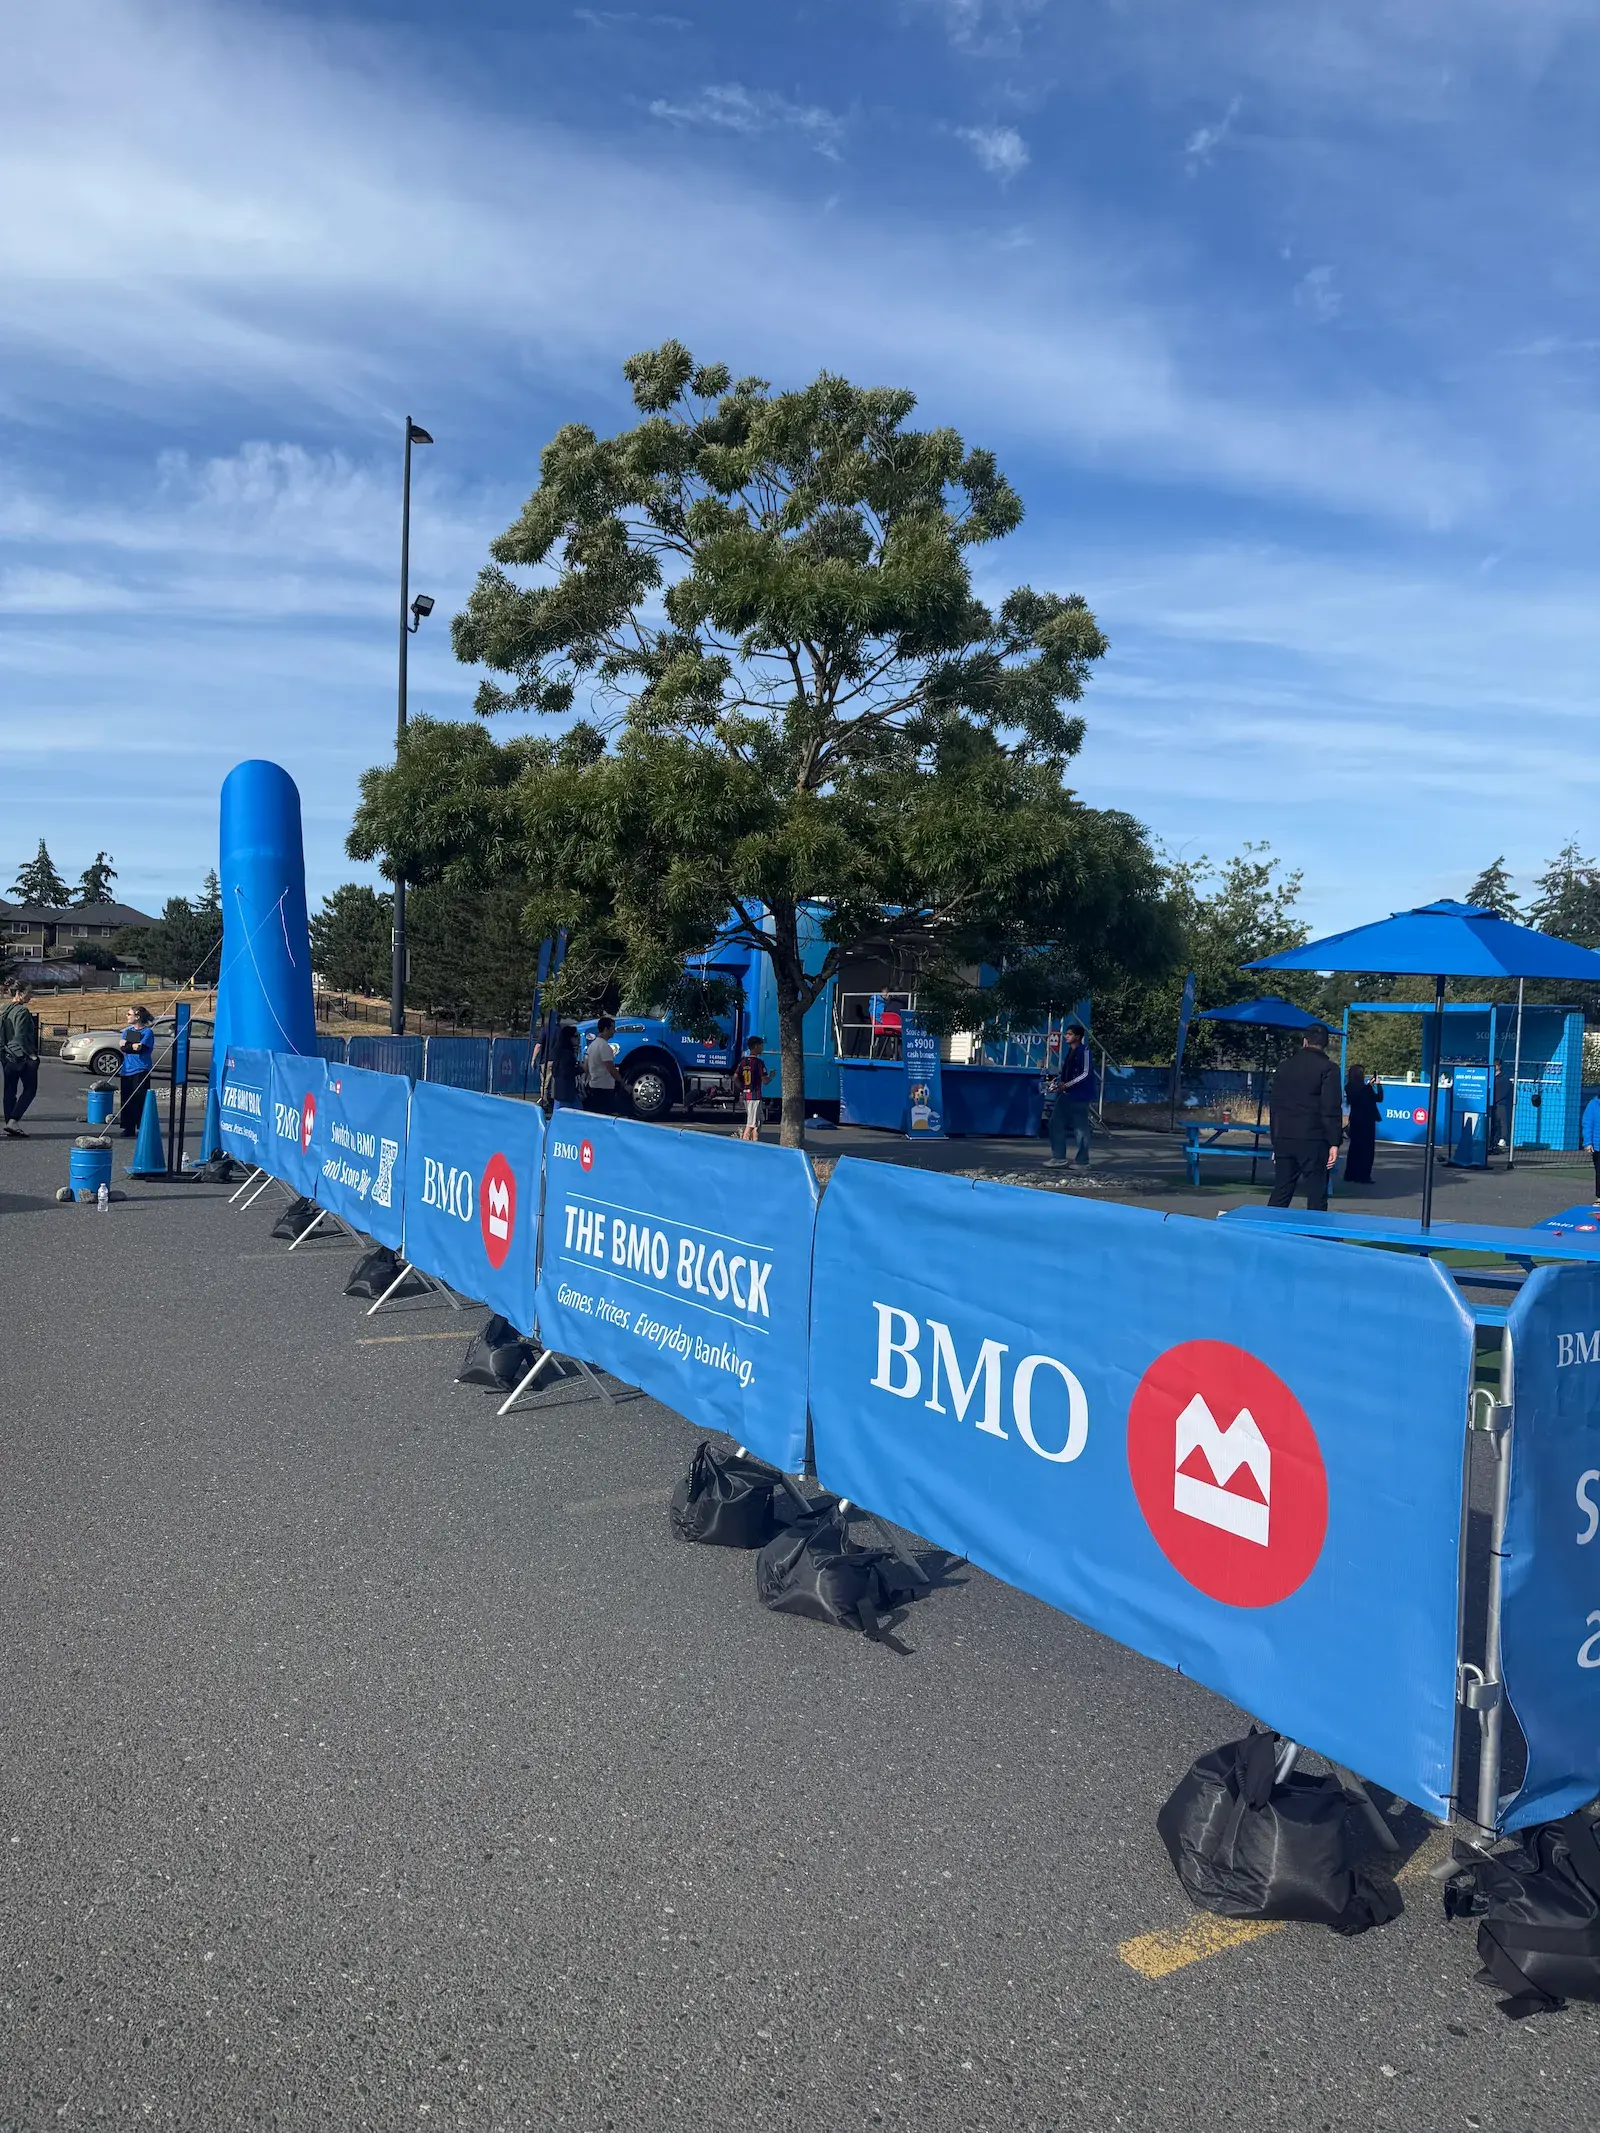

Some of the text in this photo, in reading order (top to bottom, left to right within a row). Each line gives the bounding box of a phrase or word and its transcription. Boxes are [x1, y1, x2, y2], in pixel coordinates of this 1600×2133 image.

[914, 1038, 934, 1050] $900
[223, 1086, 237, 1108] THE
[1386, 1108, 1411, 1120] BMO
[275, 1103, 300, 1142] BMO
[331, 1121, 350, 1149] Switch
[356, 1131, 375, 1158] BMO
[553, 1141, 578, 1161] BMO
[322, 1156, 372, 1201] and Score Big
[421, 1156, 473, 1222] BMO
[564, 1205, 772, 1318] THE BMO BLOCK
[557, 1282, 756, 1388] Games. Prizes. Everyday Banking.
[870, 1301, 1089, 1464] BMO
